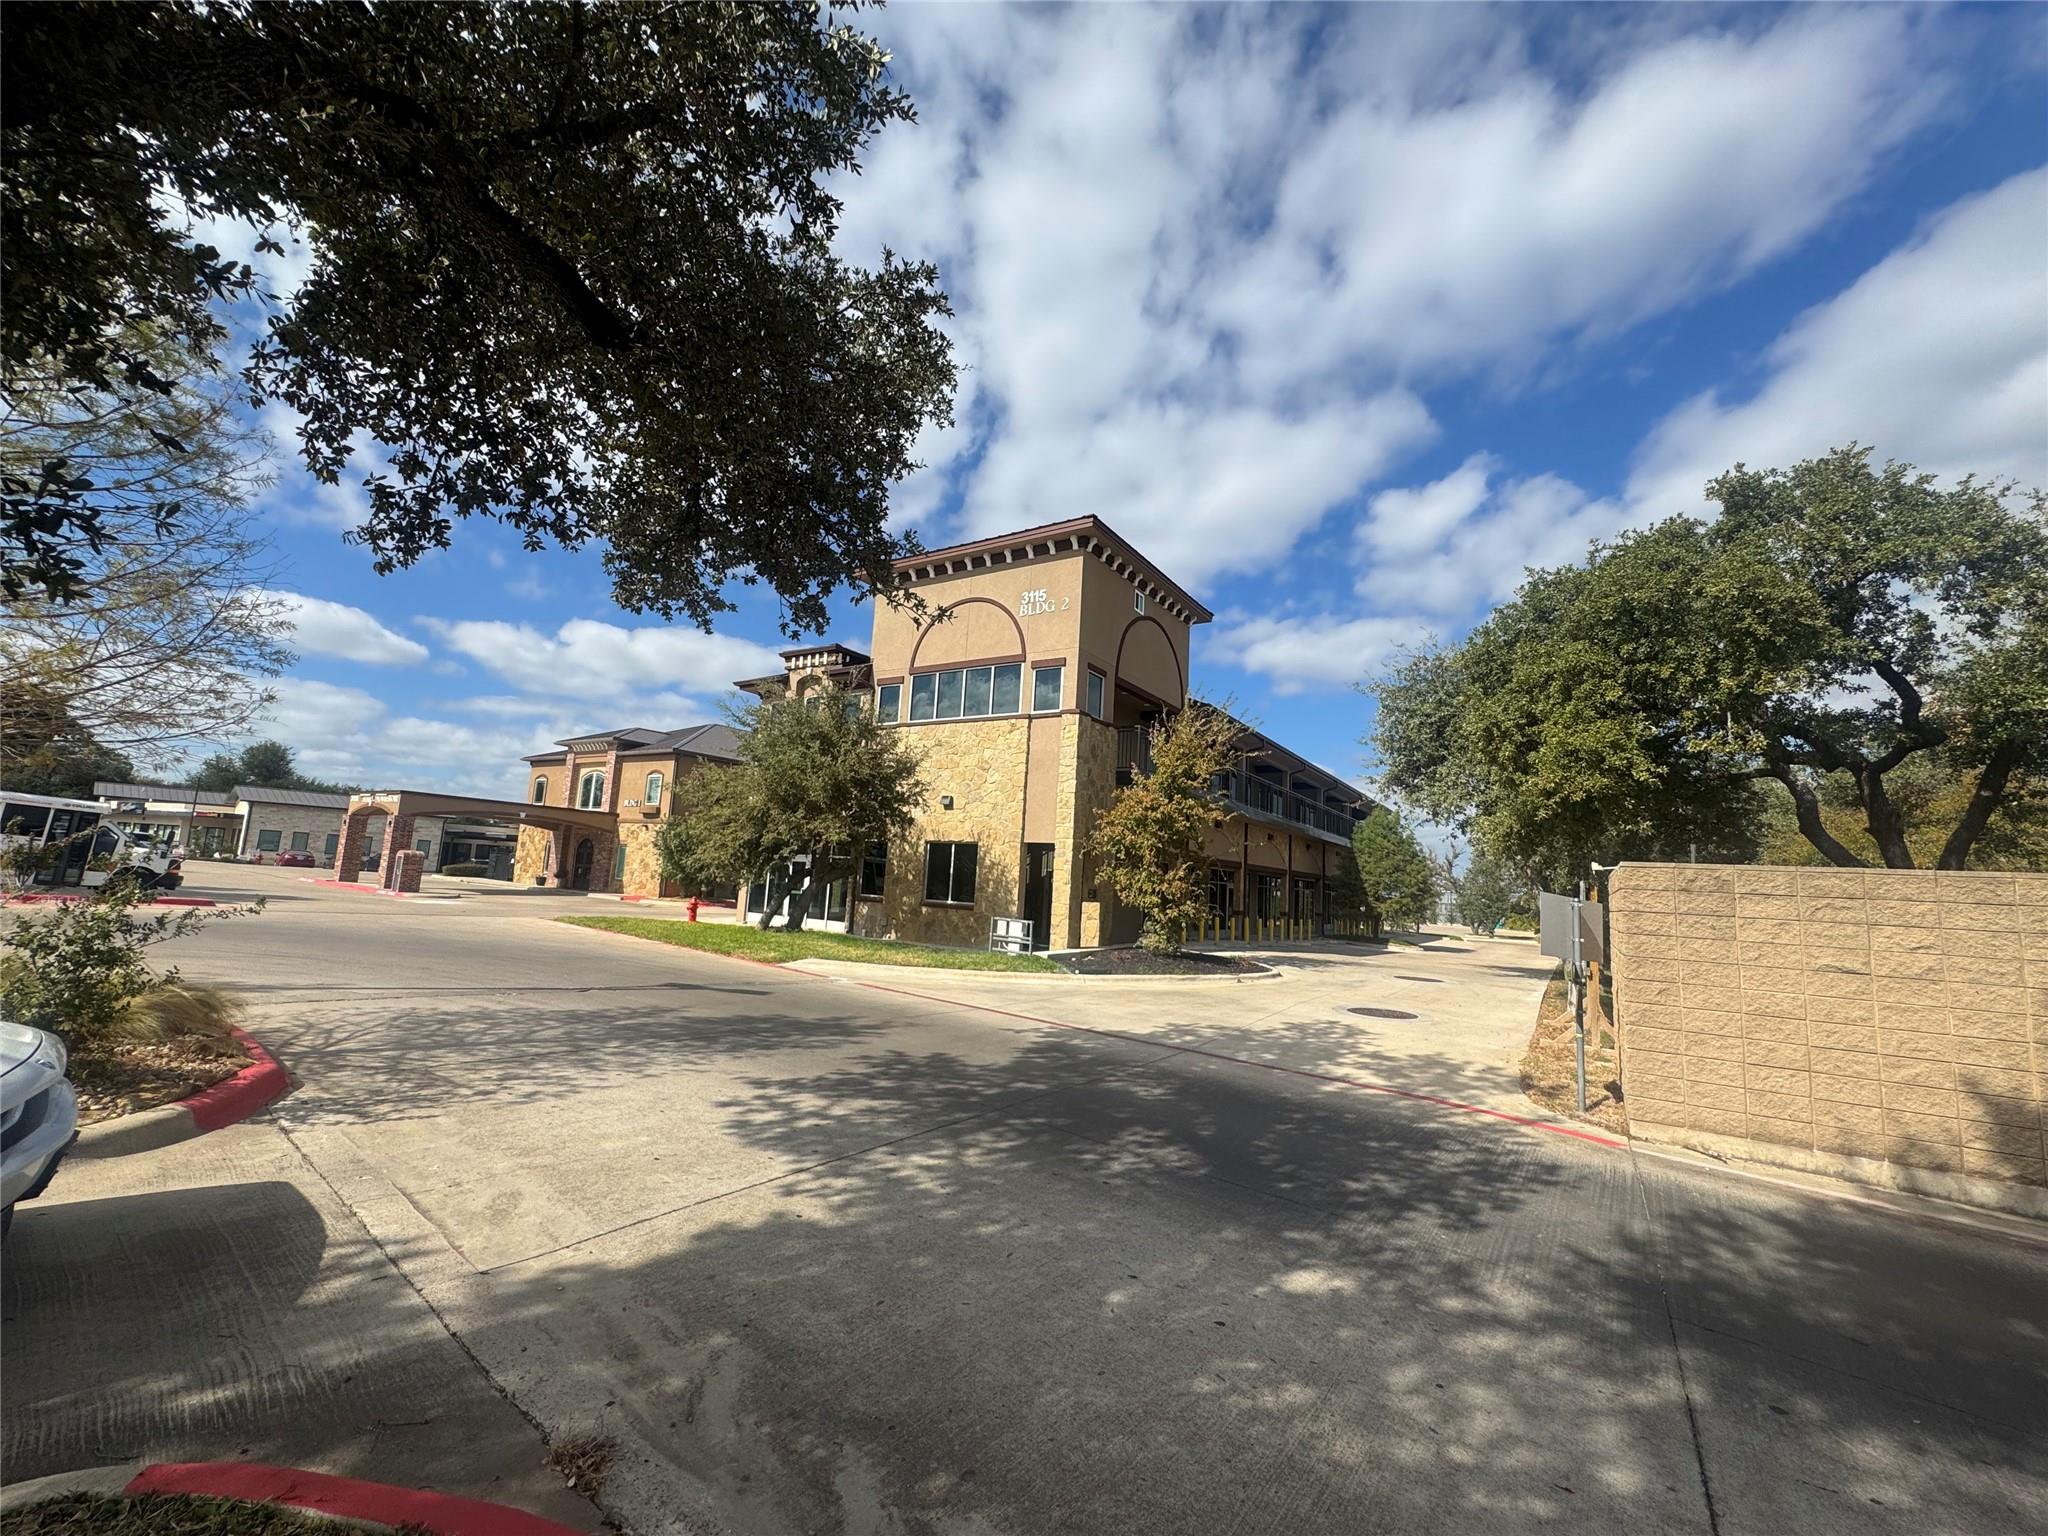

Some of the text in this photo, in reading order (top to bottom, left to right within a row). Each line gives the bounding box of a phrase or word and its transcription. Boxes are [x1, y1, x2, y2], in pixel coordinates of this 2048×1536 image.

[1021, 588, 1047, 604] 3115
[1019, 596, 1070, 617] BLDG 2
